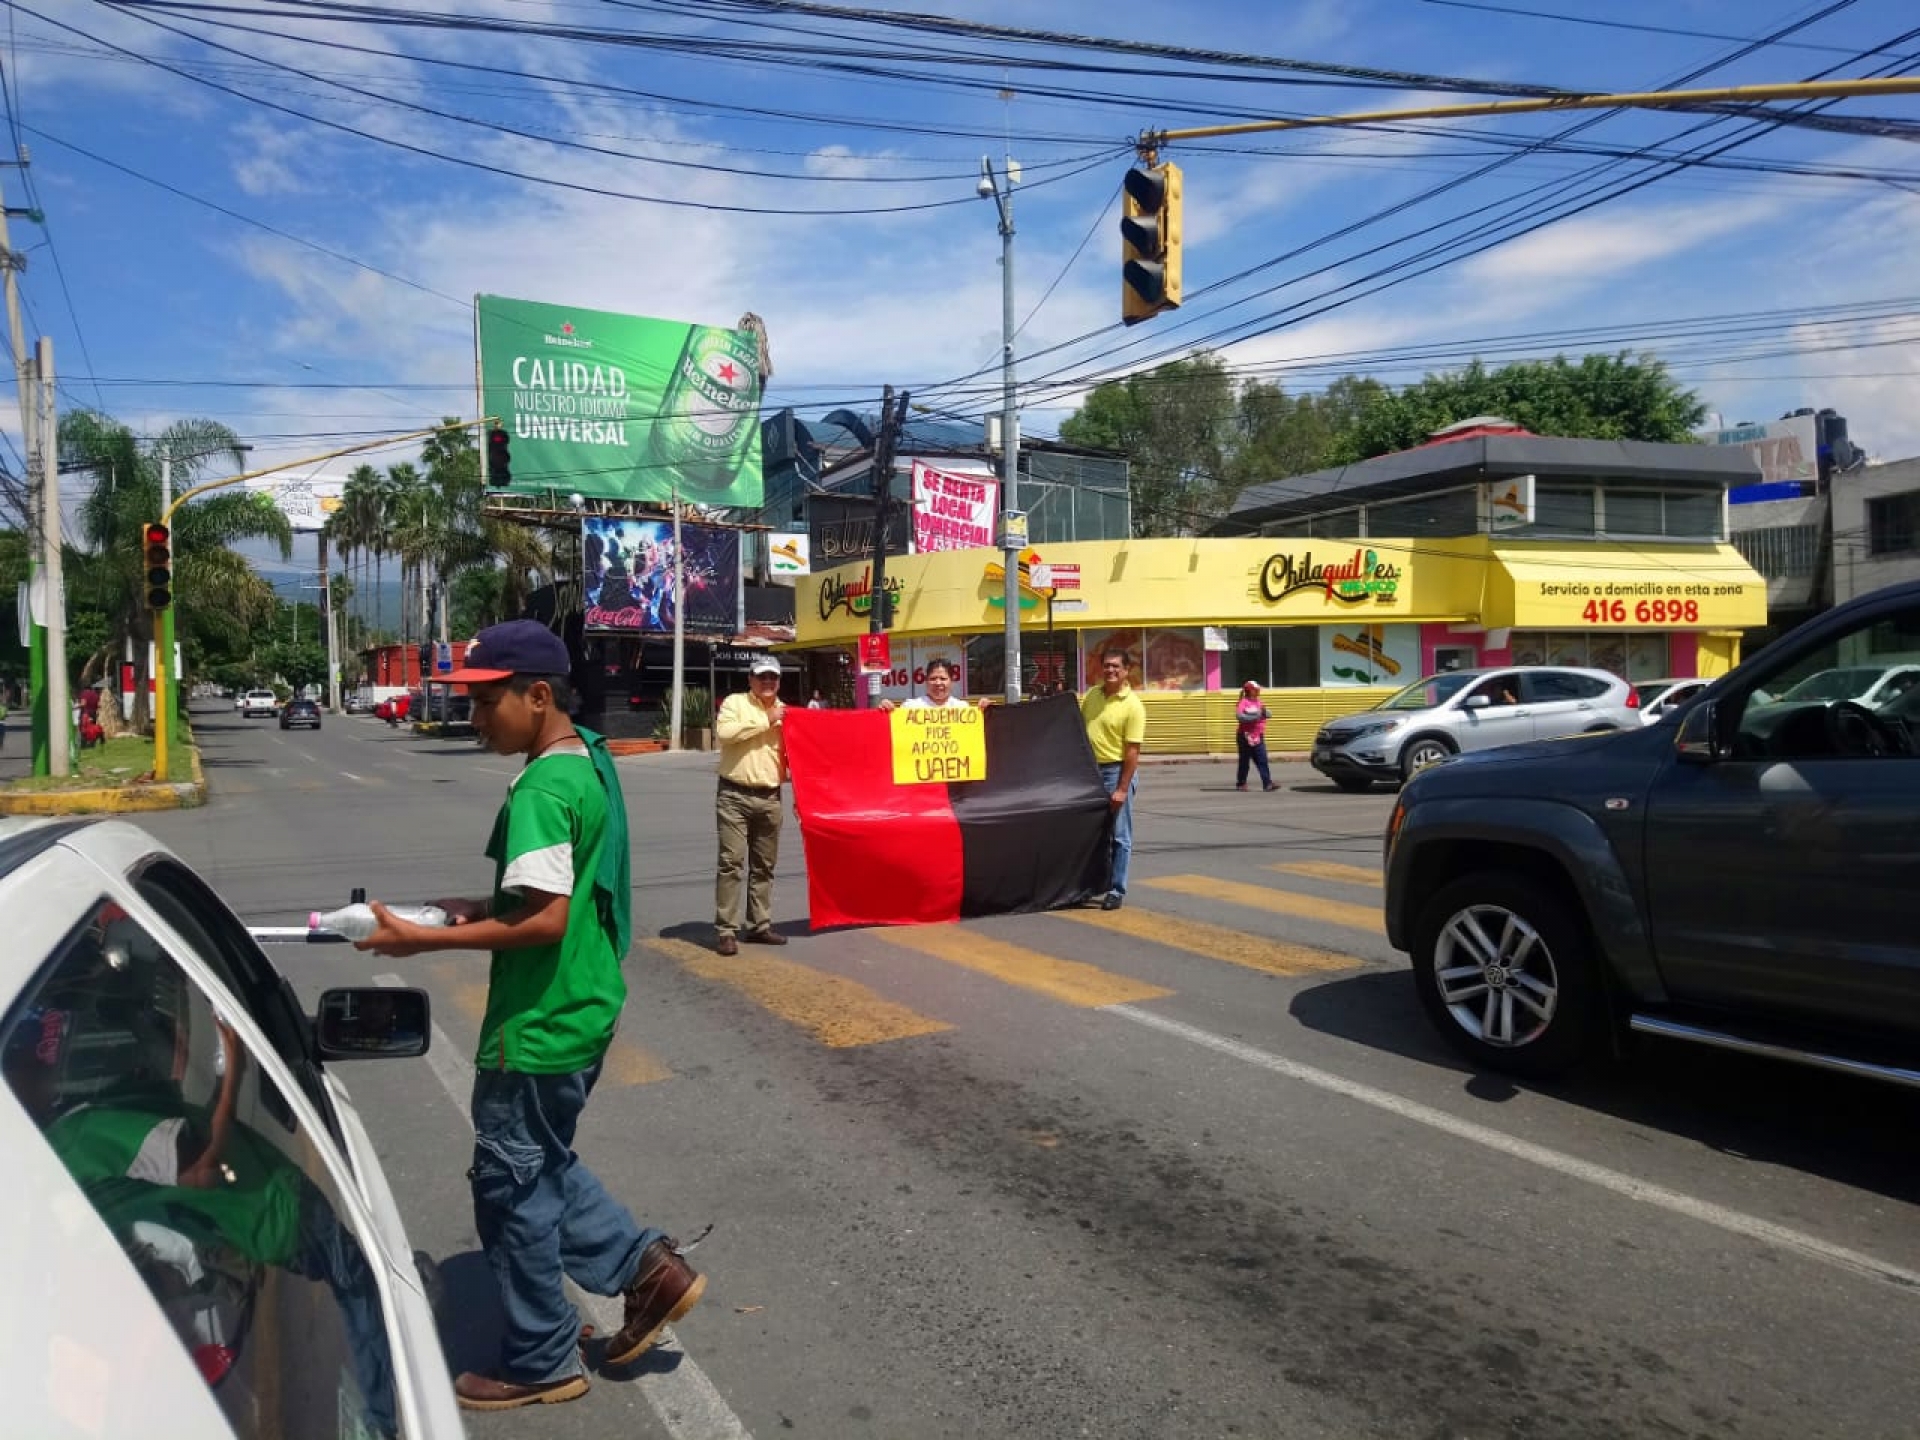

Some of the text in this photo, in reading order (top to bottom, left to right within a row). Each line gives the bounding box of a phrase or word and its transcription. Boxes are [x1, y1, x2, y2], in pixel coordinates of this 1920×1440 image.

[514, 390, 627, 419] NUESTRO IDIOMA
[515, 413, 630, 447] UNIVERSAL
[923, 470, 985, 504] SE RENTA
[931, 494, 972, 520] LOCAL
[914, 511, 989, 546] COMERCIAL
[1541, 582, 1744, 596] Servicio a domicilio en esta zona
[1582, 599, 1700, 623] 416 6898
[881, 668, 908, 687] 416
[906, 706, 978, 725] ACADEMICO
[911, 740, 959, 756] APOYO
[915, 756, 970, 781] UAEM
